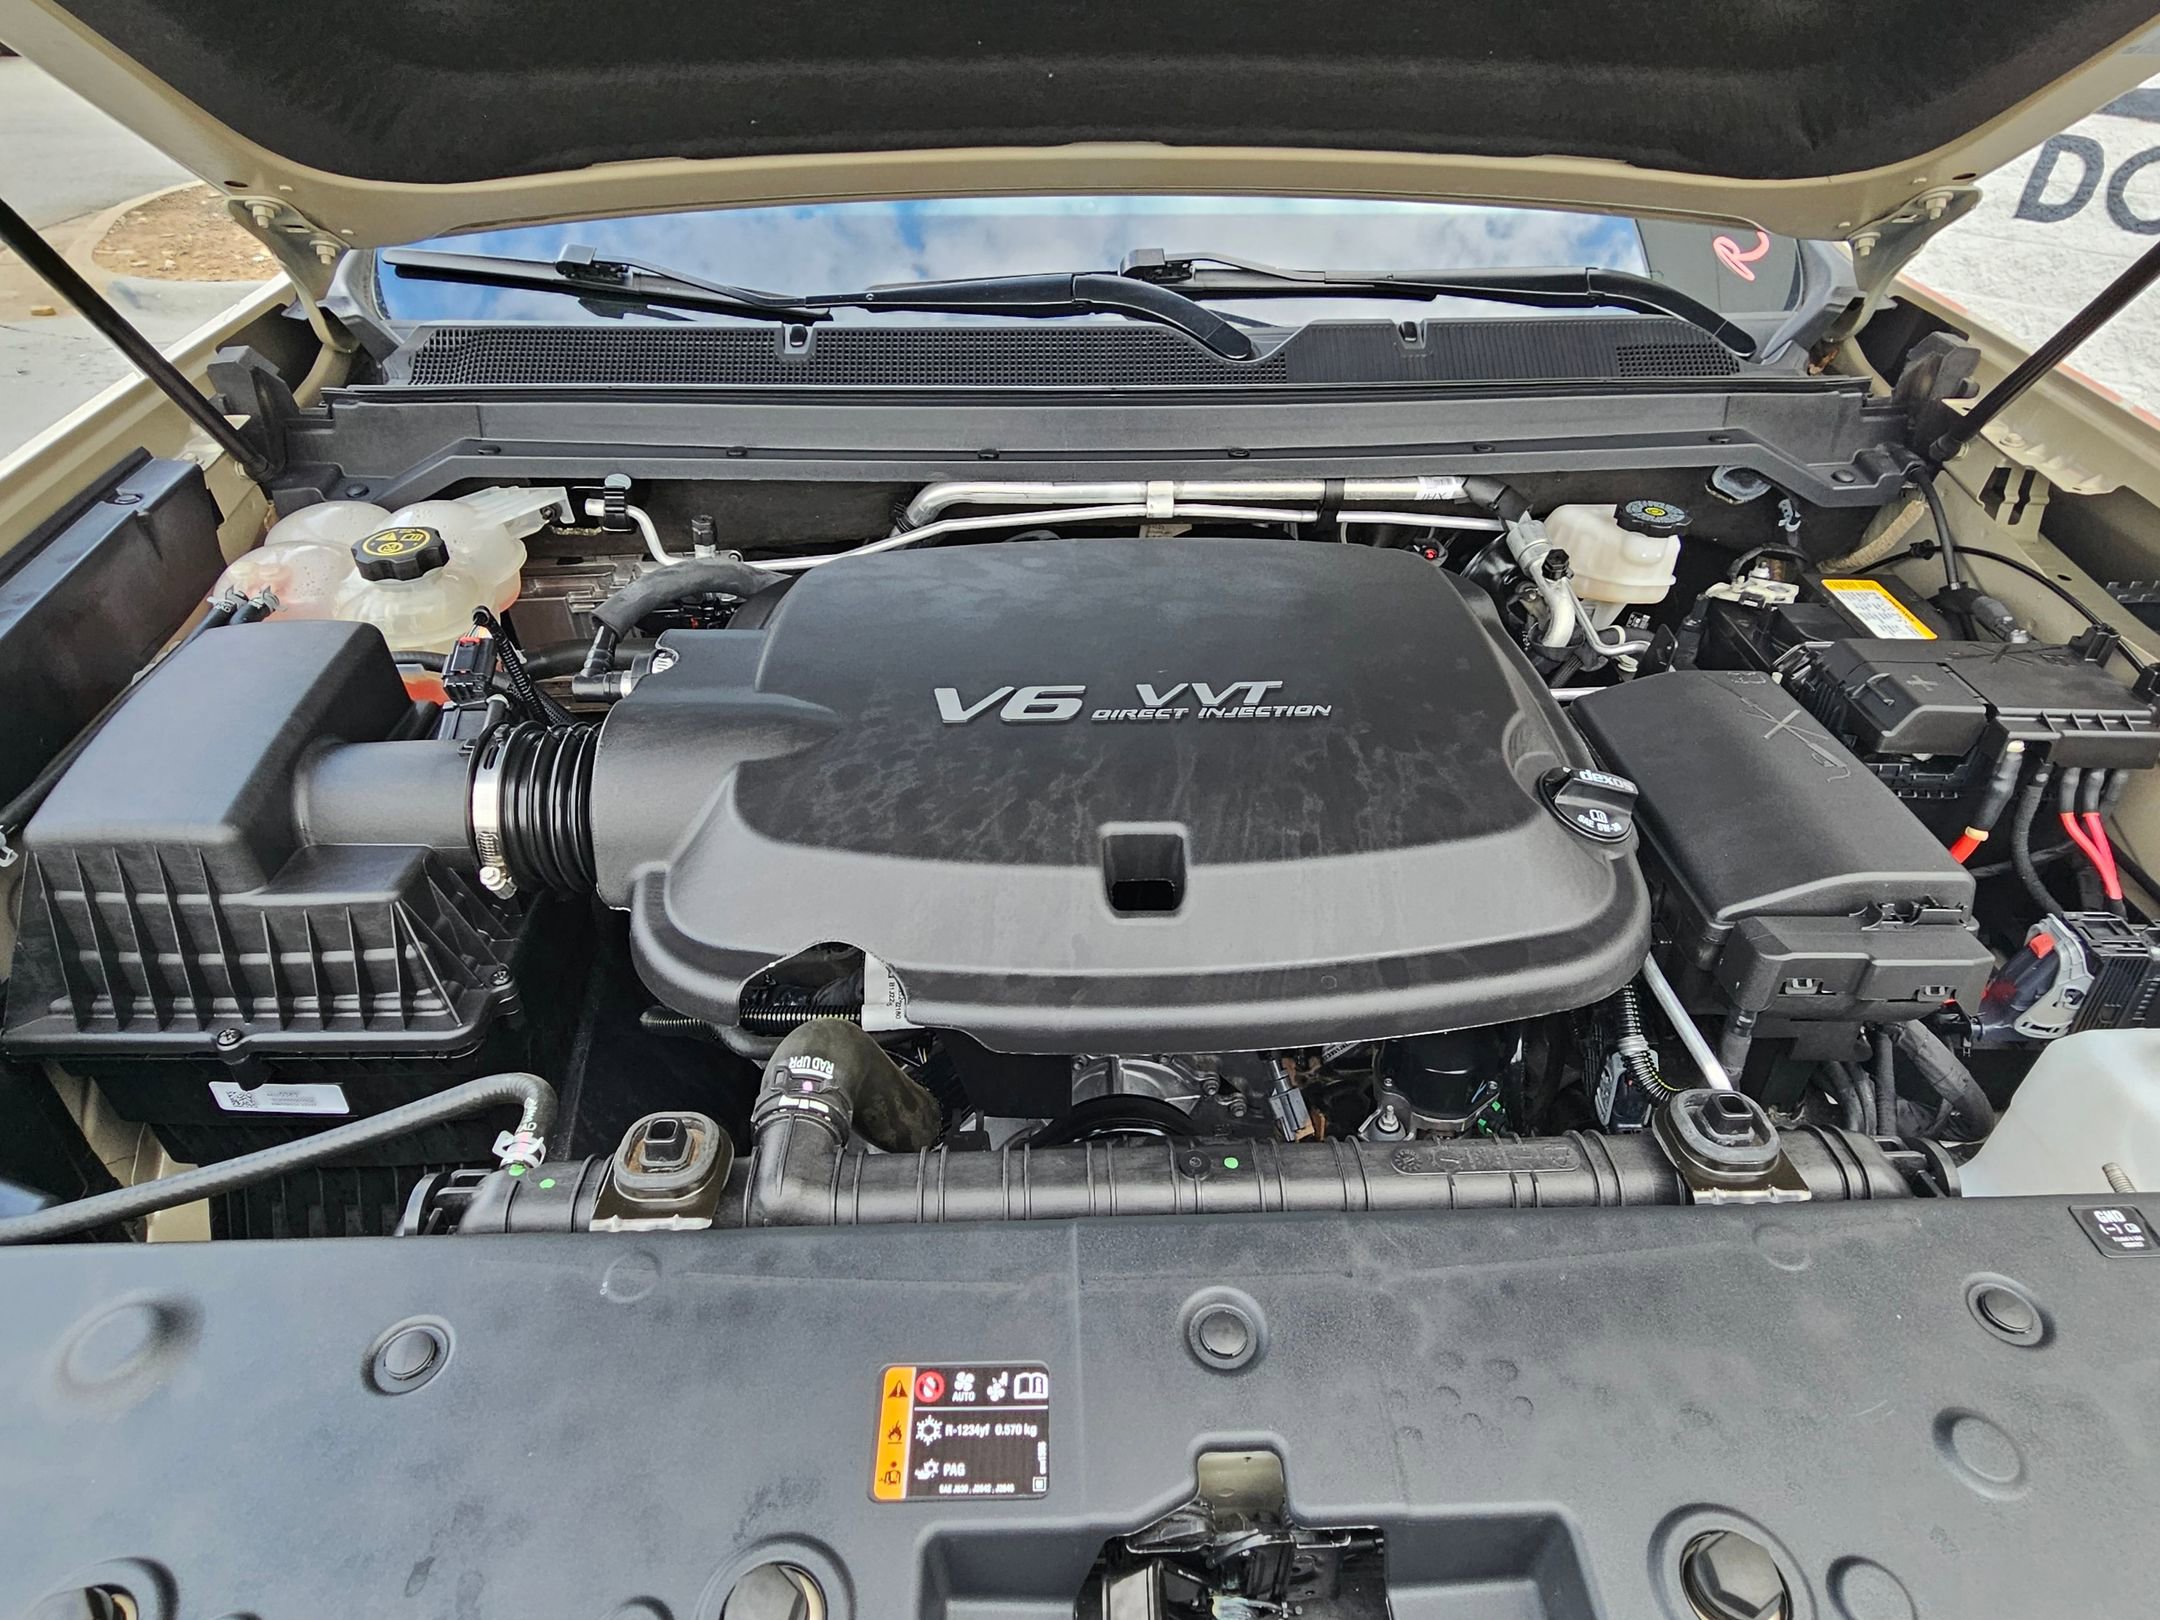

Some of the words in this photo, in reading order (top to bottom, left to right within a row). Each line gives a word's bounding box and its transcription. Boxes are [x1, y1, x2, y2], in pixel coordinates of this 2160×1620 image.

[1136, 681, 1283, 706] VVT
[934, 685, 1086, 723] V6
[1091, 708, 1189, 720] DIRECT
[1198, 705, 1332, 719] INJECTION
[1579, 770, 1635, 793] dexos
[788, 1056, 811, 1069] UPR
[812, 1057, 835, 1074] RAD
[2093, 1209, 2127, 1223] GND
[952, 1391, 976, 1402] AUTO
[945, 1424, 990, 1438] R-1234yf
[994, 1423, 1023, 1437] 0.570
[1024, 1423, 1038, 1438] kg
[943, 1463, 966, 1476] PAG
